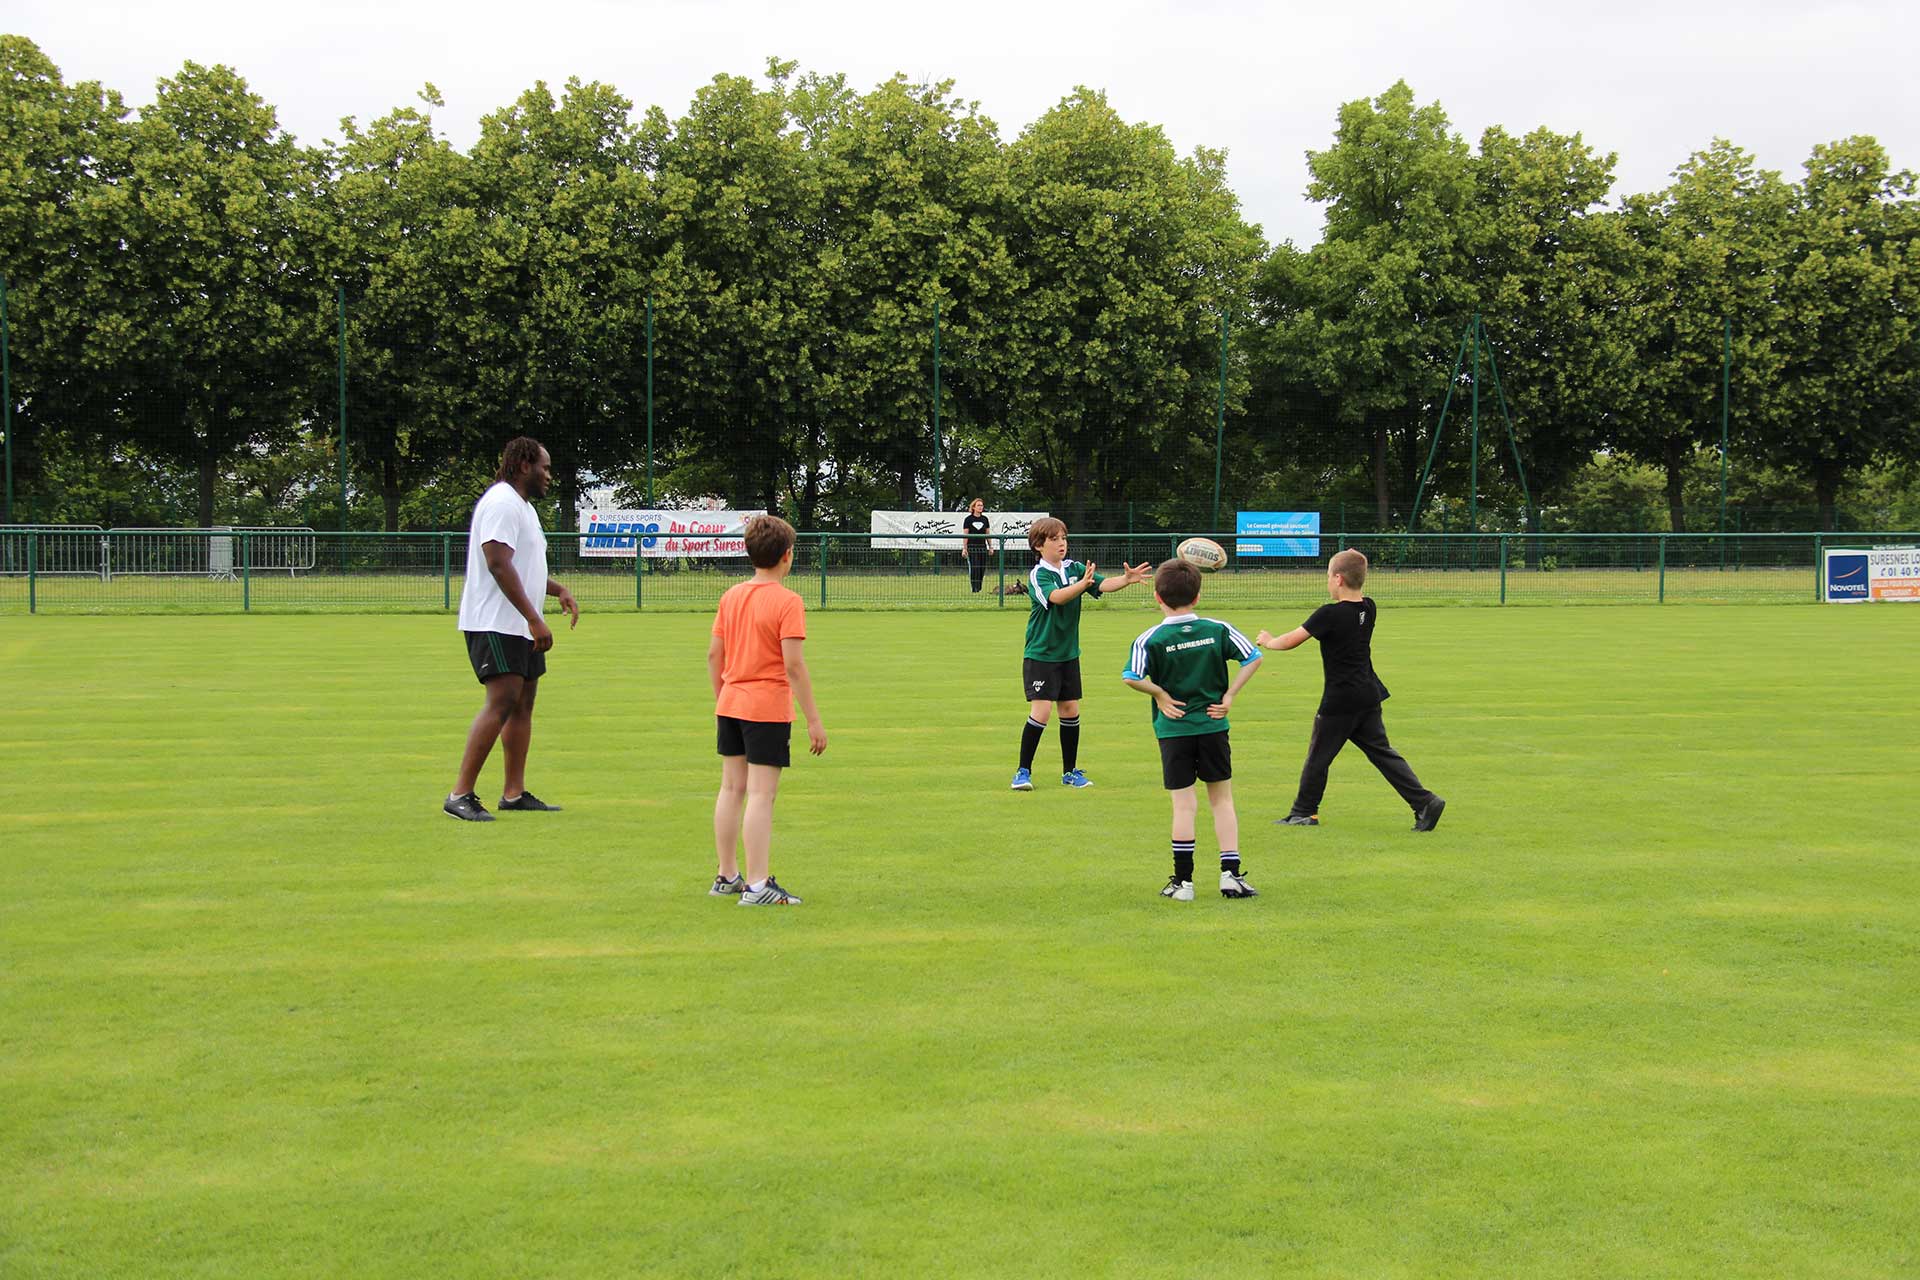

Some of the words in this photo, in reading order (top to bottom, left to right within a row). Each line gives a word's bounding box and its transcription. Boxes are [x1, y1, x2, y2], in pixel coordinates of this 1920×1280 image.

[636, 514, 662, 522] SPORTS
[669, 520, 686, 534] Au
[689, 520, 727, 534] Coeur
[665, 537, 678, 552] du
[681, 538, 711, 554] Sport
[1184, 545, 1220, 562] SUMMIT
[1870, 553, 1909, 566] SURESNES
[1888, 567, 1897, 577] 01
[1900, 567, 1911, 577] 40
[1829, 583, 1867, 592] NOVOTEL
[1165, 644, 1177, 653] RC
[1176, 637, 1216, 650] SURESNES
